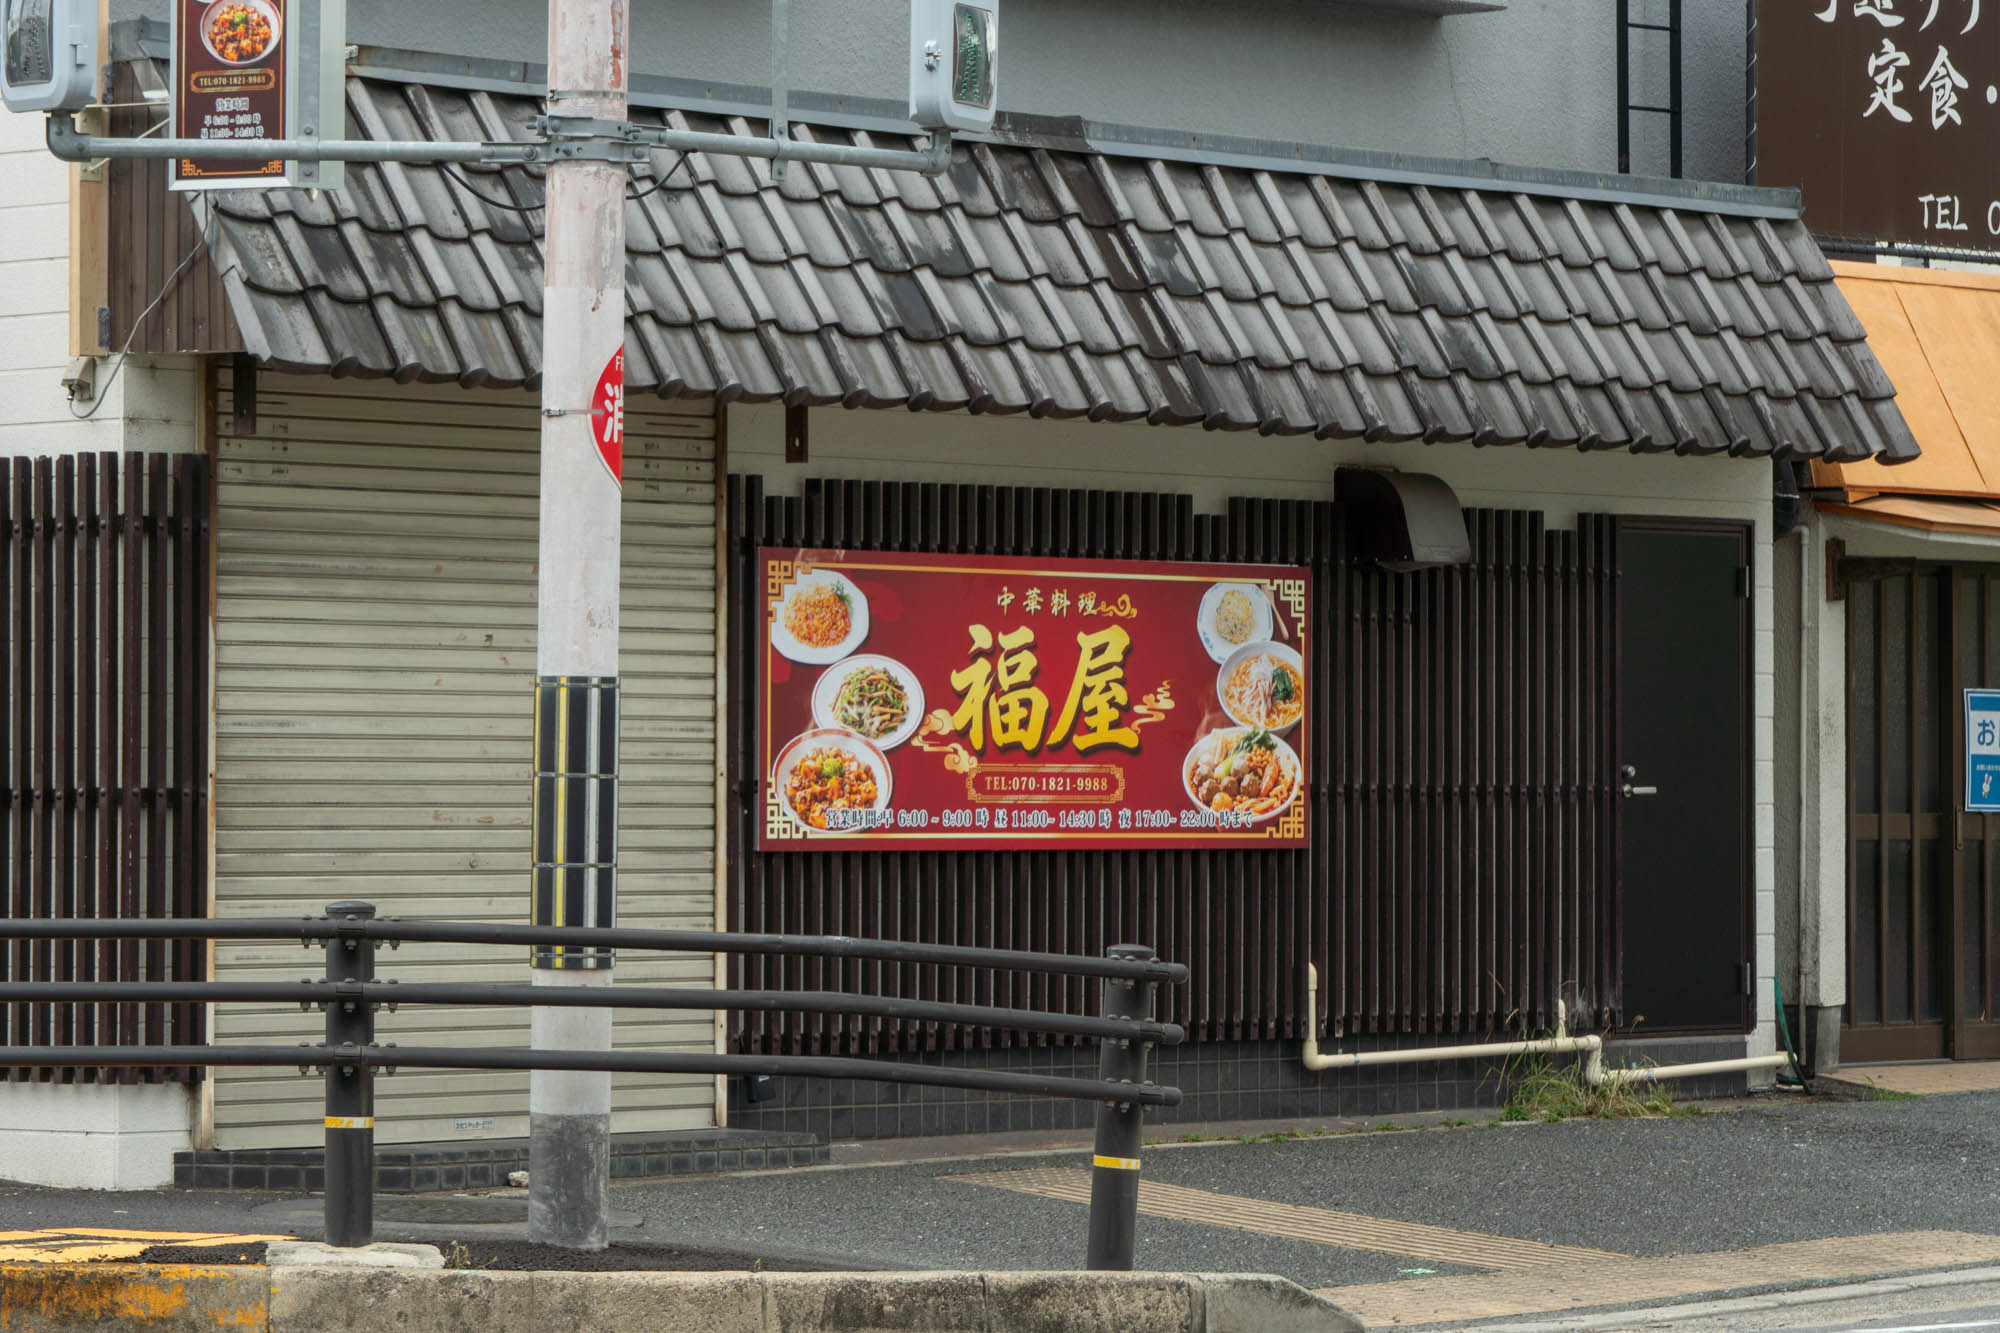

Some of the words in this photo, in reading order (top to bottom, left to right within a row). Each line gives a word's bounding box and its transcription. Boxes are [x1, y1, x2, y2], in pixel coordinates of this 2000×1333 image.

[1918, 193, 1968, 230] TEL
[997, 586, 1097, 618] 中華料理
[950, 624, 1139, 751] 福屋
[1977, 719, 2000, 747] お
[984, 776, 1108, 791] TEL:070-1821-9988
[898, 809, 928, 827] 6:00
[942, 809, 972, 827] 9:00
[975, 808, 988, 828] 時
[1059, 810, 1096, 827] 14:30
[1098, 808, 1112, 829] 時
[1118, 808, 1131, 829] 夜
[1180, 810, 1215, 827] 22:00
[1219, 809, 1253, 829] 時まで
